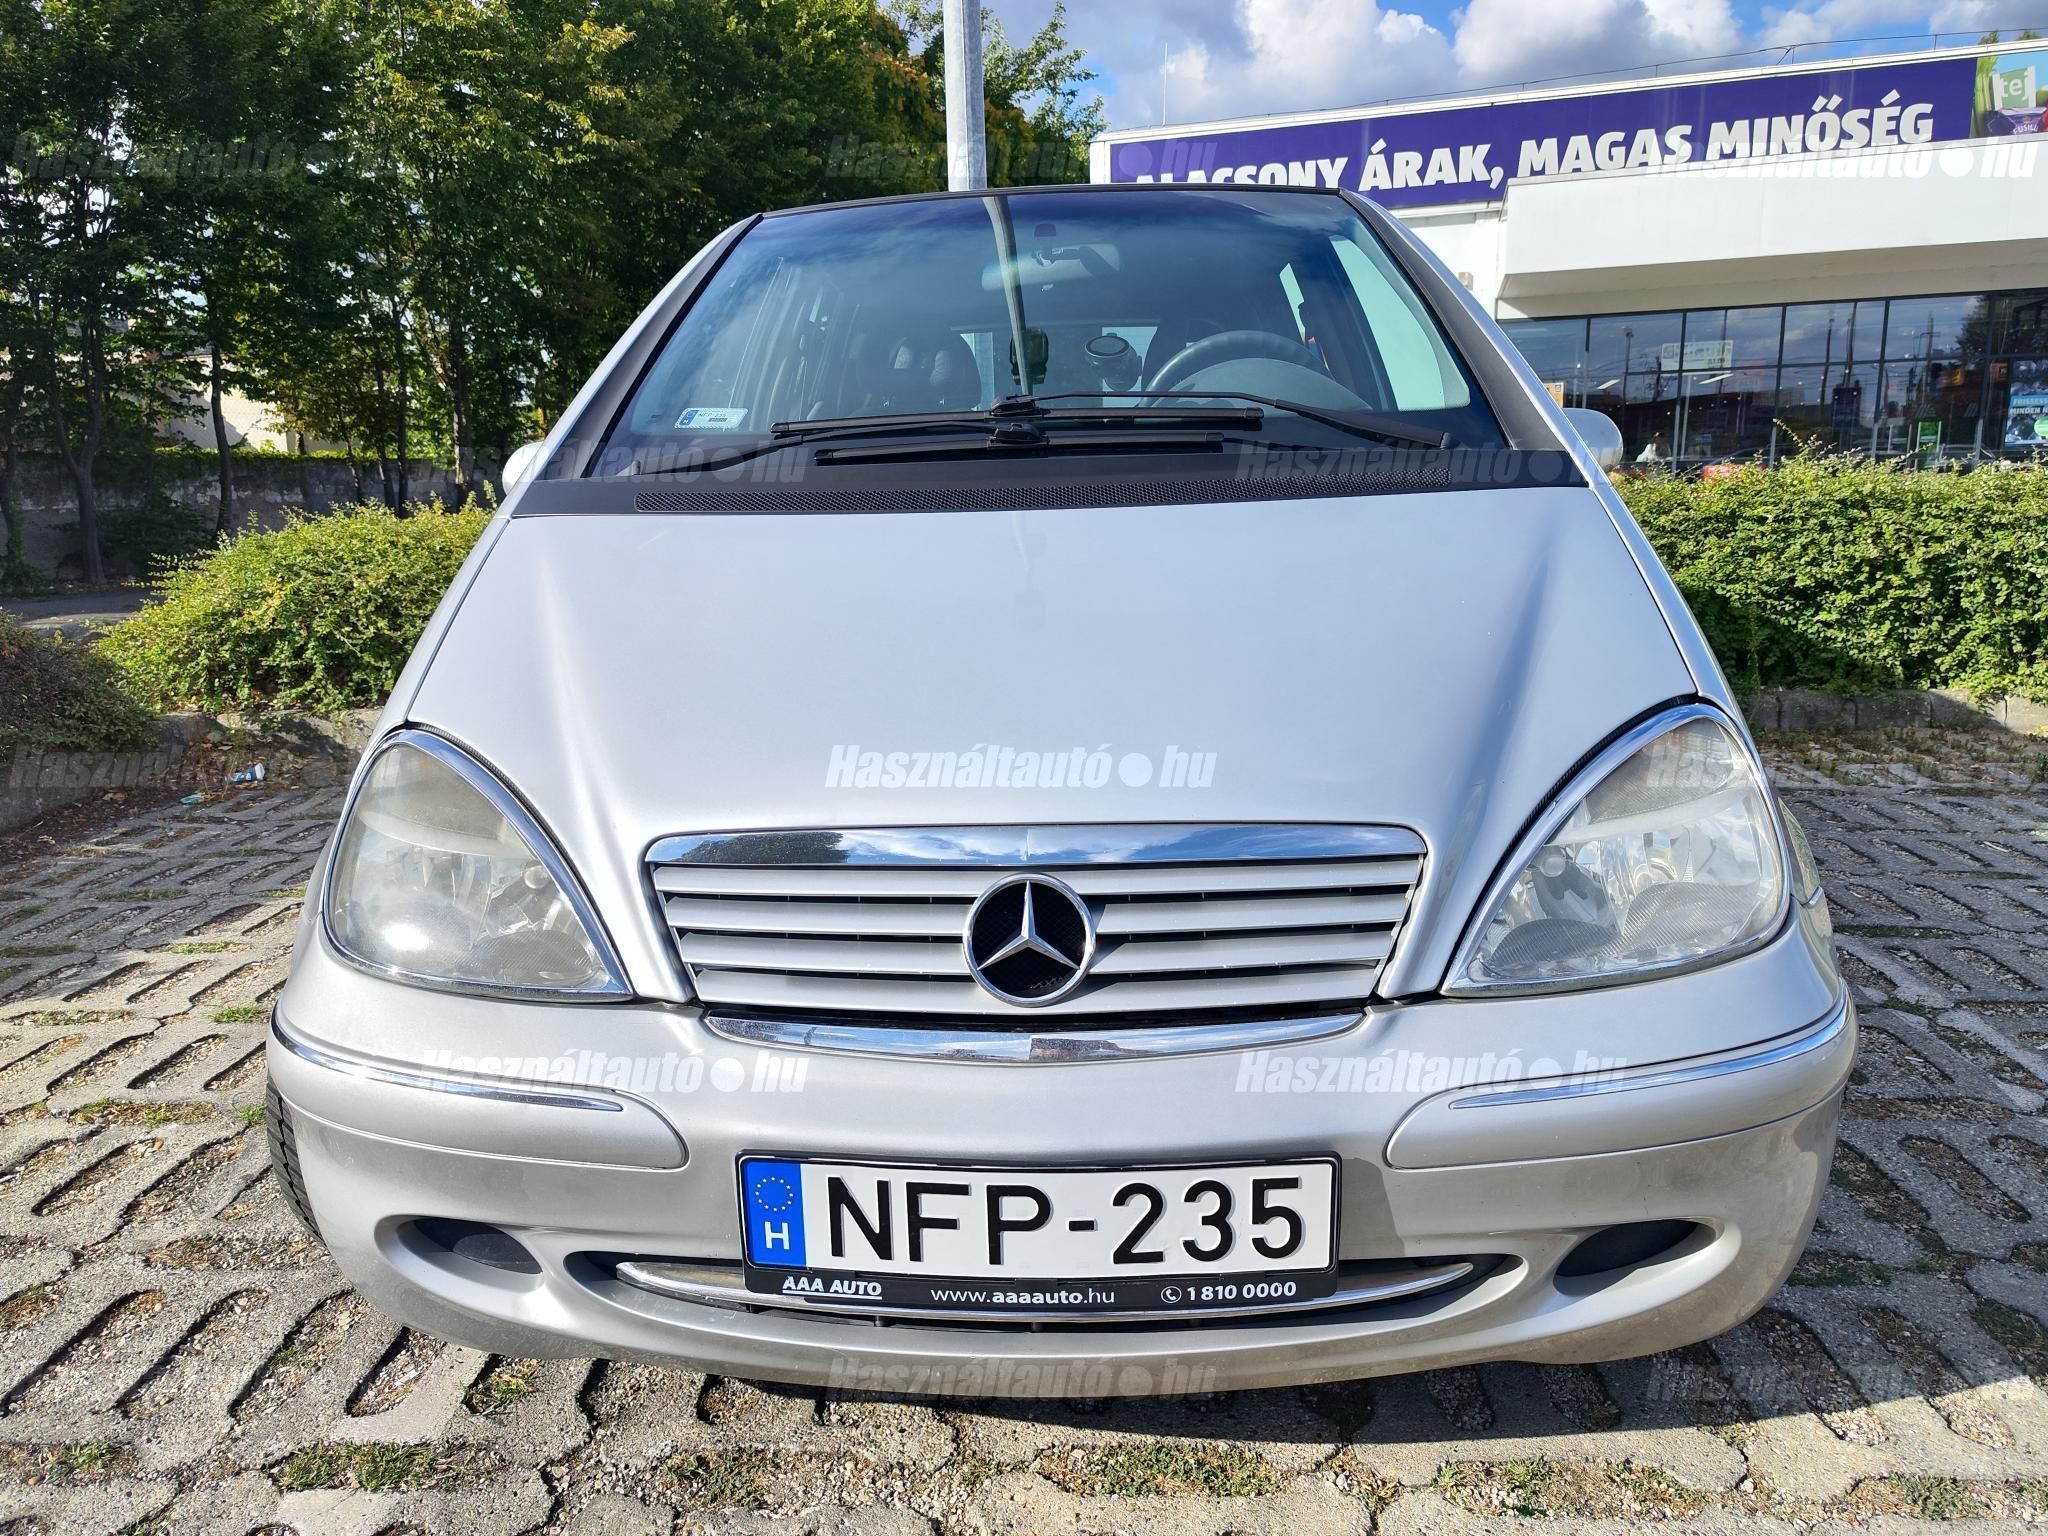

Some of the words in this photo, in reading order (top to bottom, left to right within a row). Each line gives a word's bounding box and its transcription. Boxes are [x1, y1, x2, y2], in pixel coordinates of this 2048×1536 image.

[2000, 70, 2031, 101] tej
[1358, 138, 1504, 192] ÁRAK,
[1517, 125, 1693, 177] MAGAS
[1705, 89, 1934, 163] MINŐSÉG
[764, 1220, 790, 1251] H
[826, 1175, 1304, 1266] NFP-235
[782, 1275, 824, 1292] AAA
[829, 1279, 882, 1296] AUTO
[930, 1287, 1116, 1304] www.aaaauto.hu
[1242, 1281, 1297, 1299] 0000
